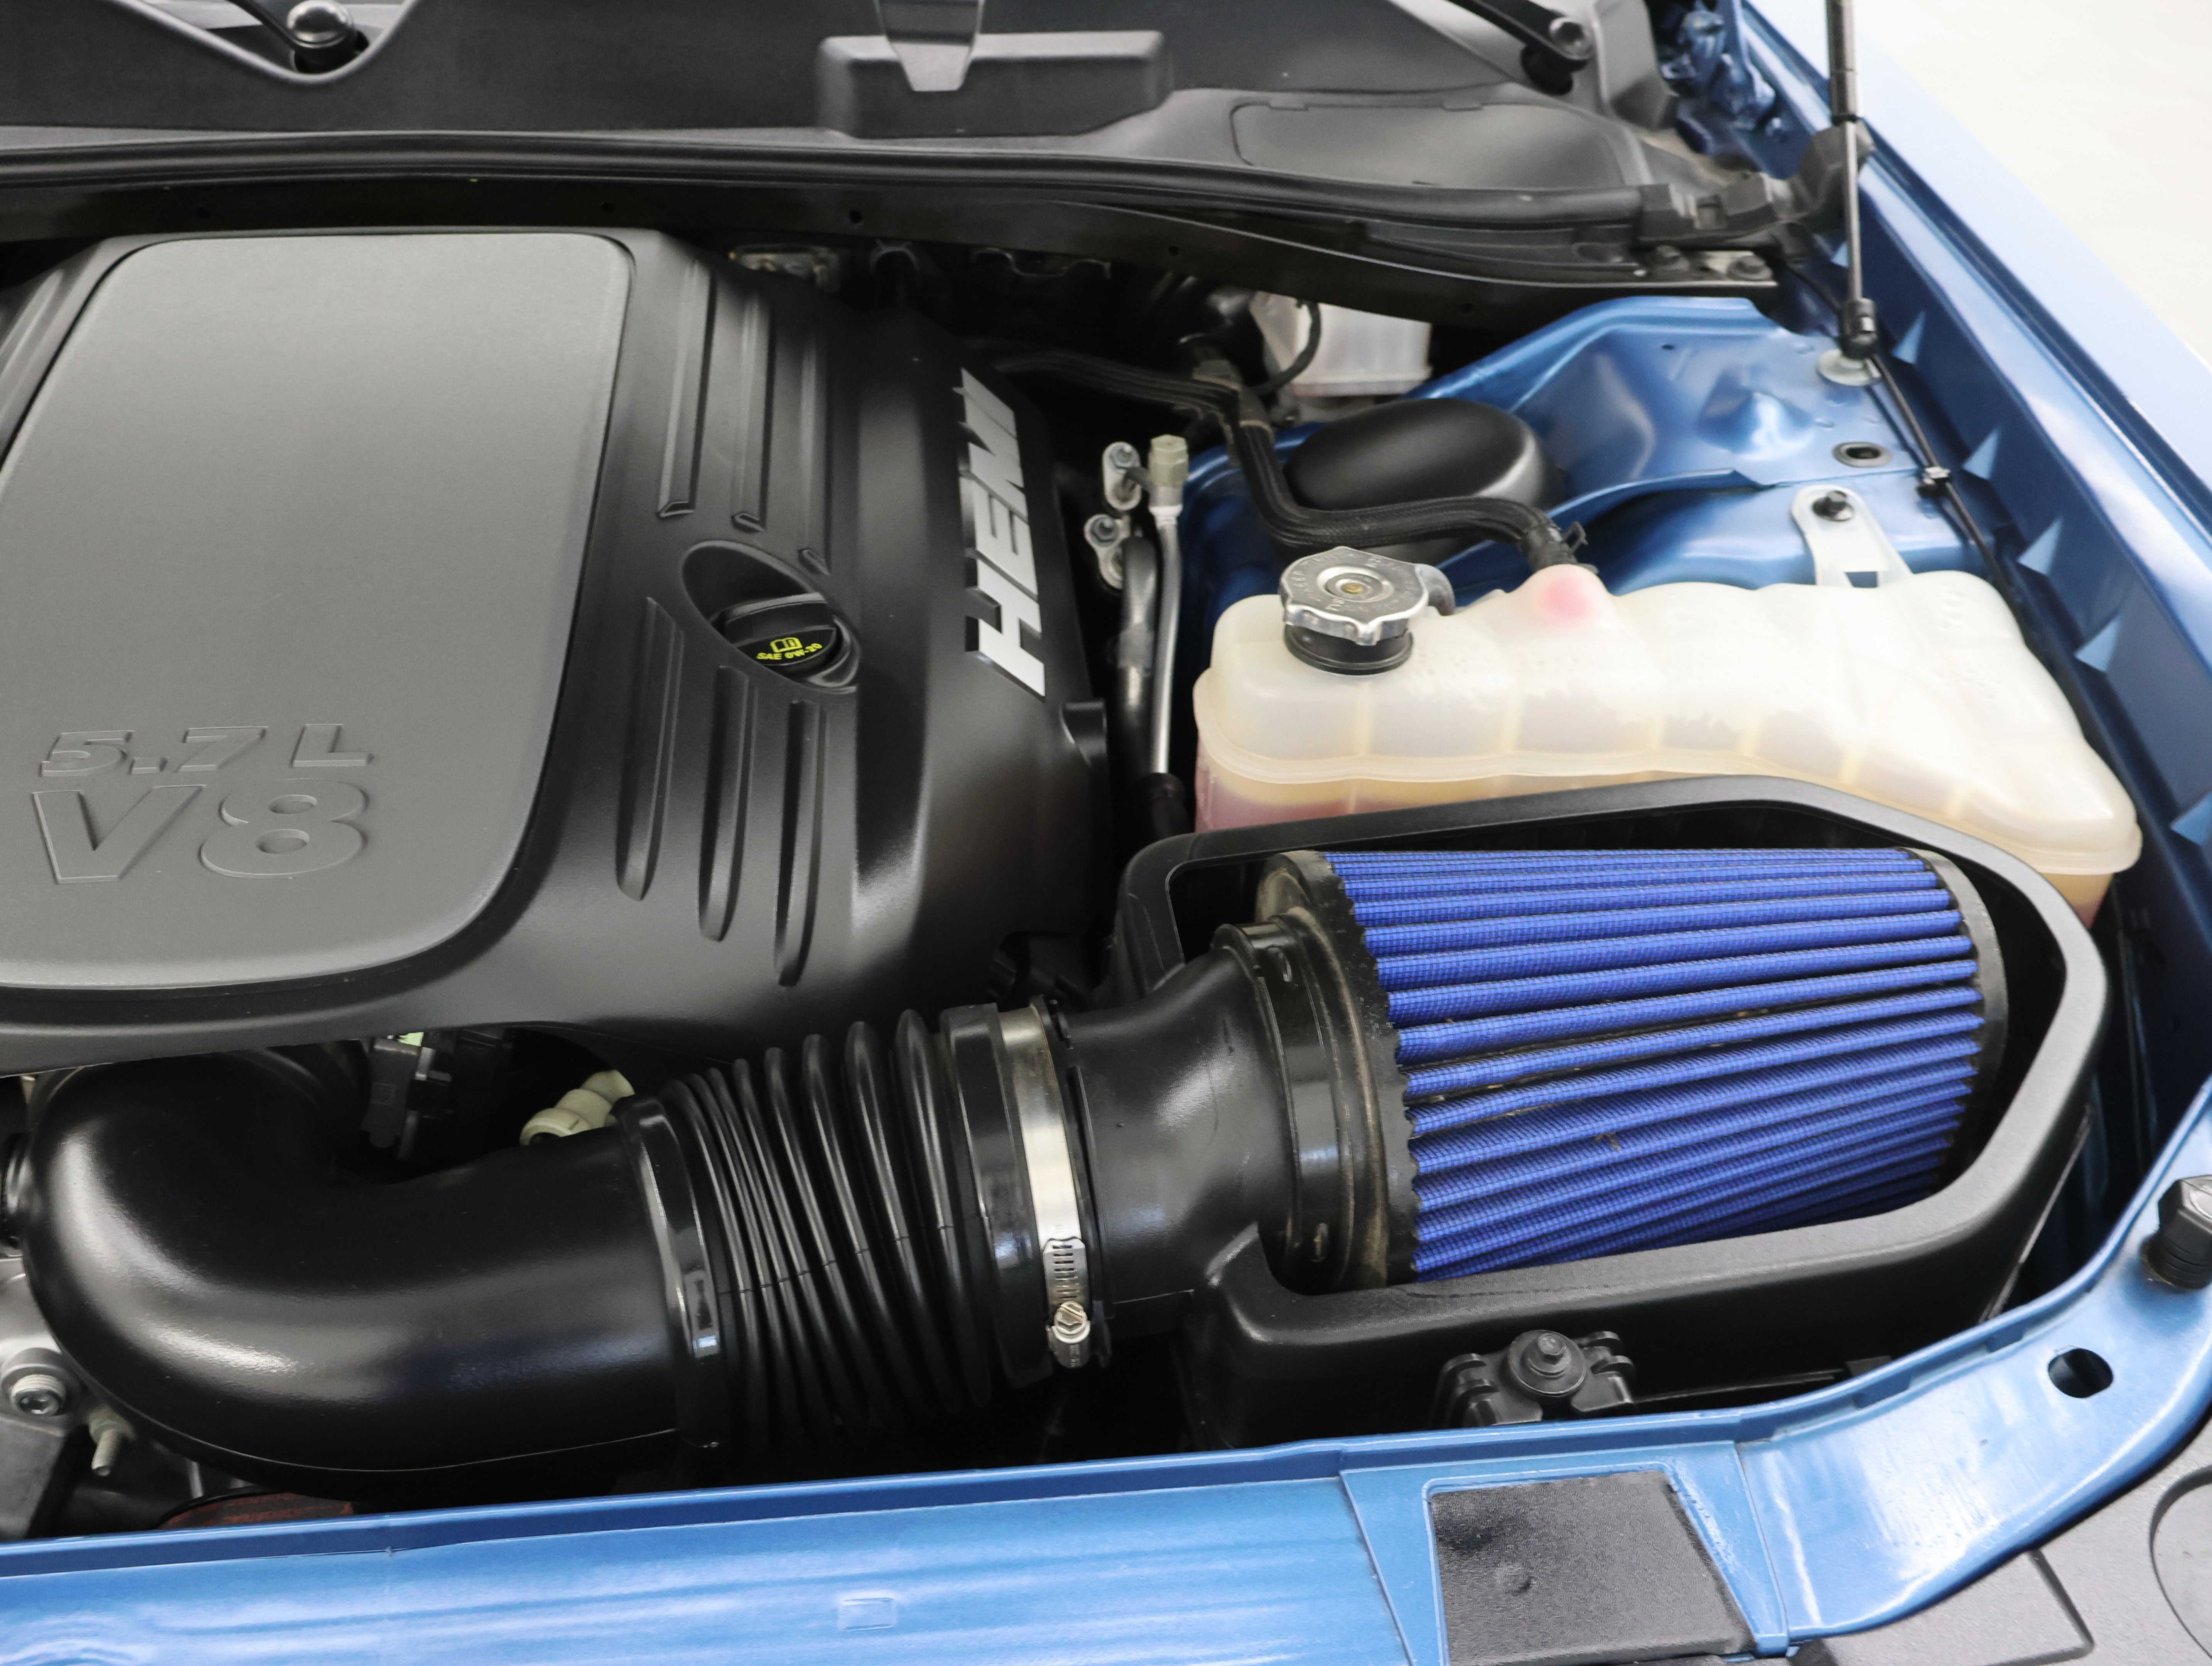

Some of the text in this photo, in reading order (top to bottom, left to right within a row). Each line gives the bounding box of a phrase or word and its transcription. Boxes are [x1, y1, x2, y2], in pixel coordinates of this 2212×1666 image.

[960, 368, 1045, 697] HEMI
[785, 643, 822, 659] 0W-20
[39, 726, 269, 776] 5.7
[32, 778, 370, 884] V8
